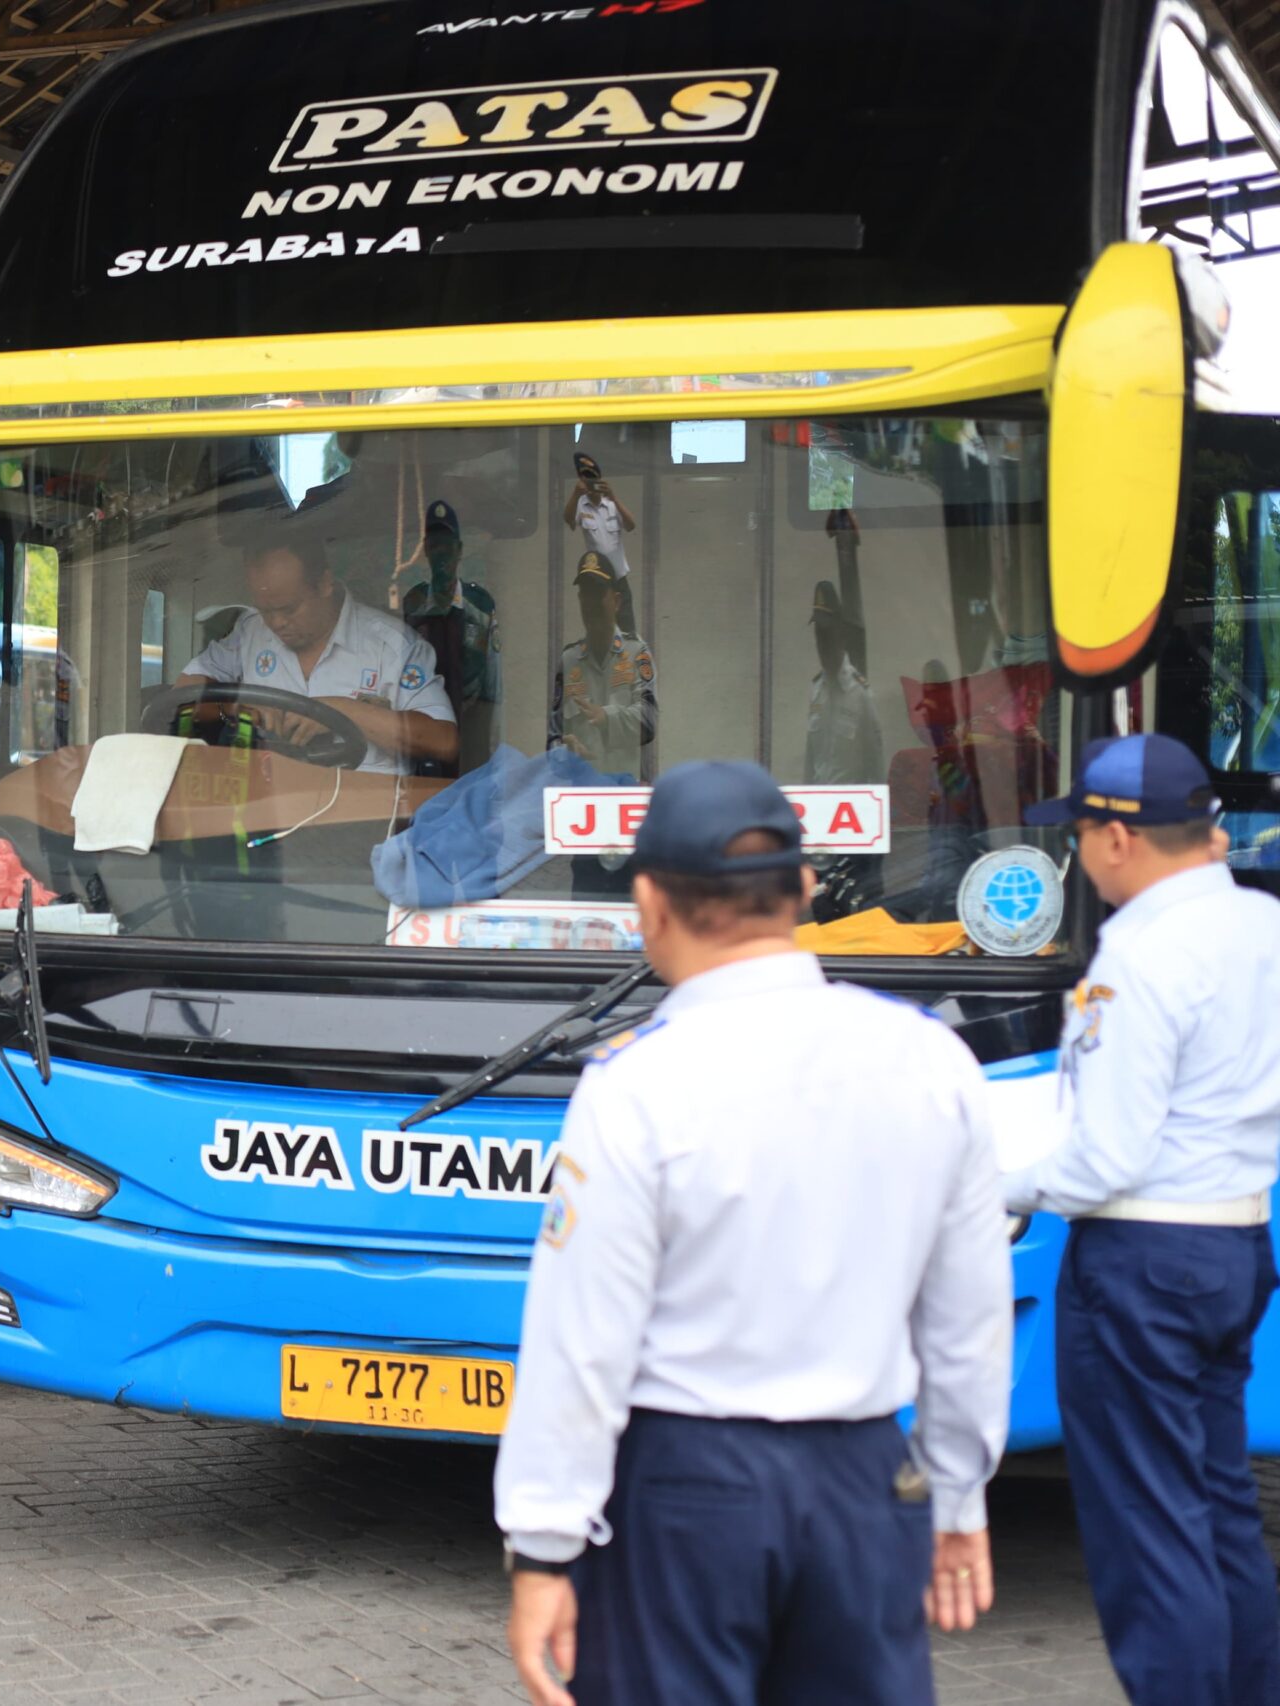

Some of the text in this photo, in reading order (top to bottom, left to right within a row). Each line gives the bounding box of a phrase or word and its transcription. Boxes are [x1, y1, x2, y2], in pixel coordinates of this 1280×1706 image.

[416, 7, 595, 35] AVANTE
[292, 80, 754, 160] PATAS
[241, 160, 745, 219] NON EKONOMI
[206, 1125, 346, 1183] JAYA
[289, 1354, 507, 1408] L 7177 UB
